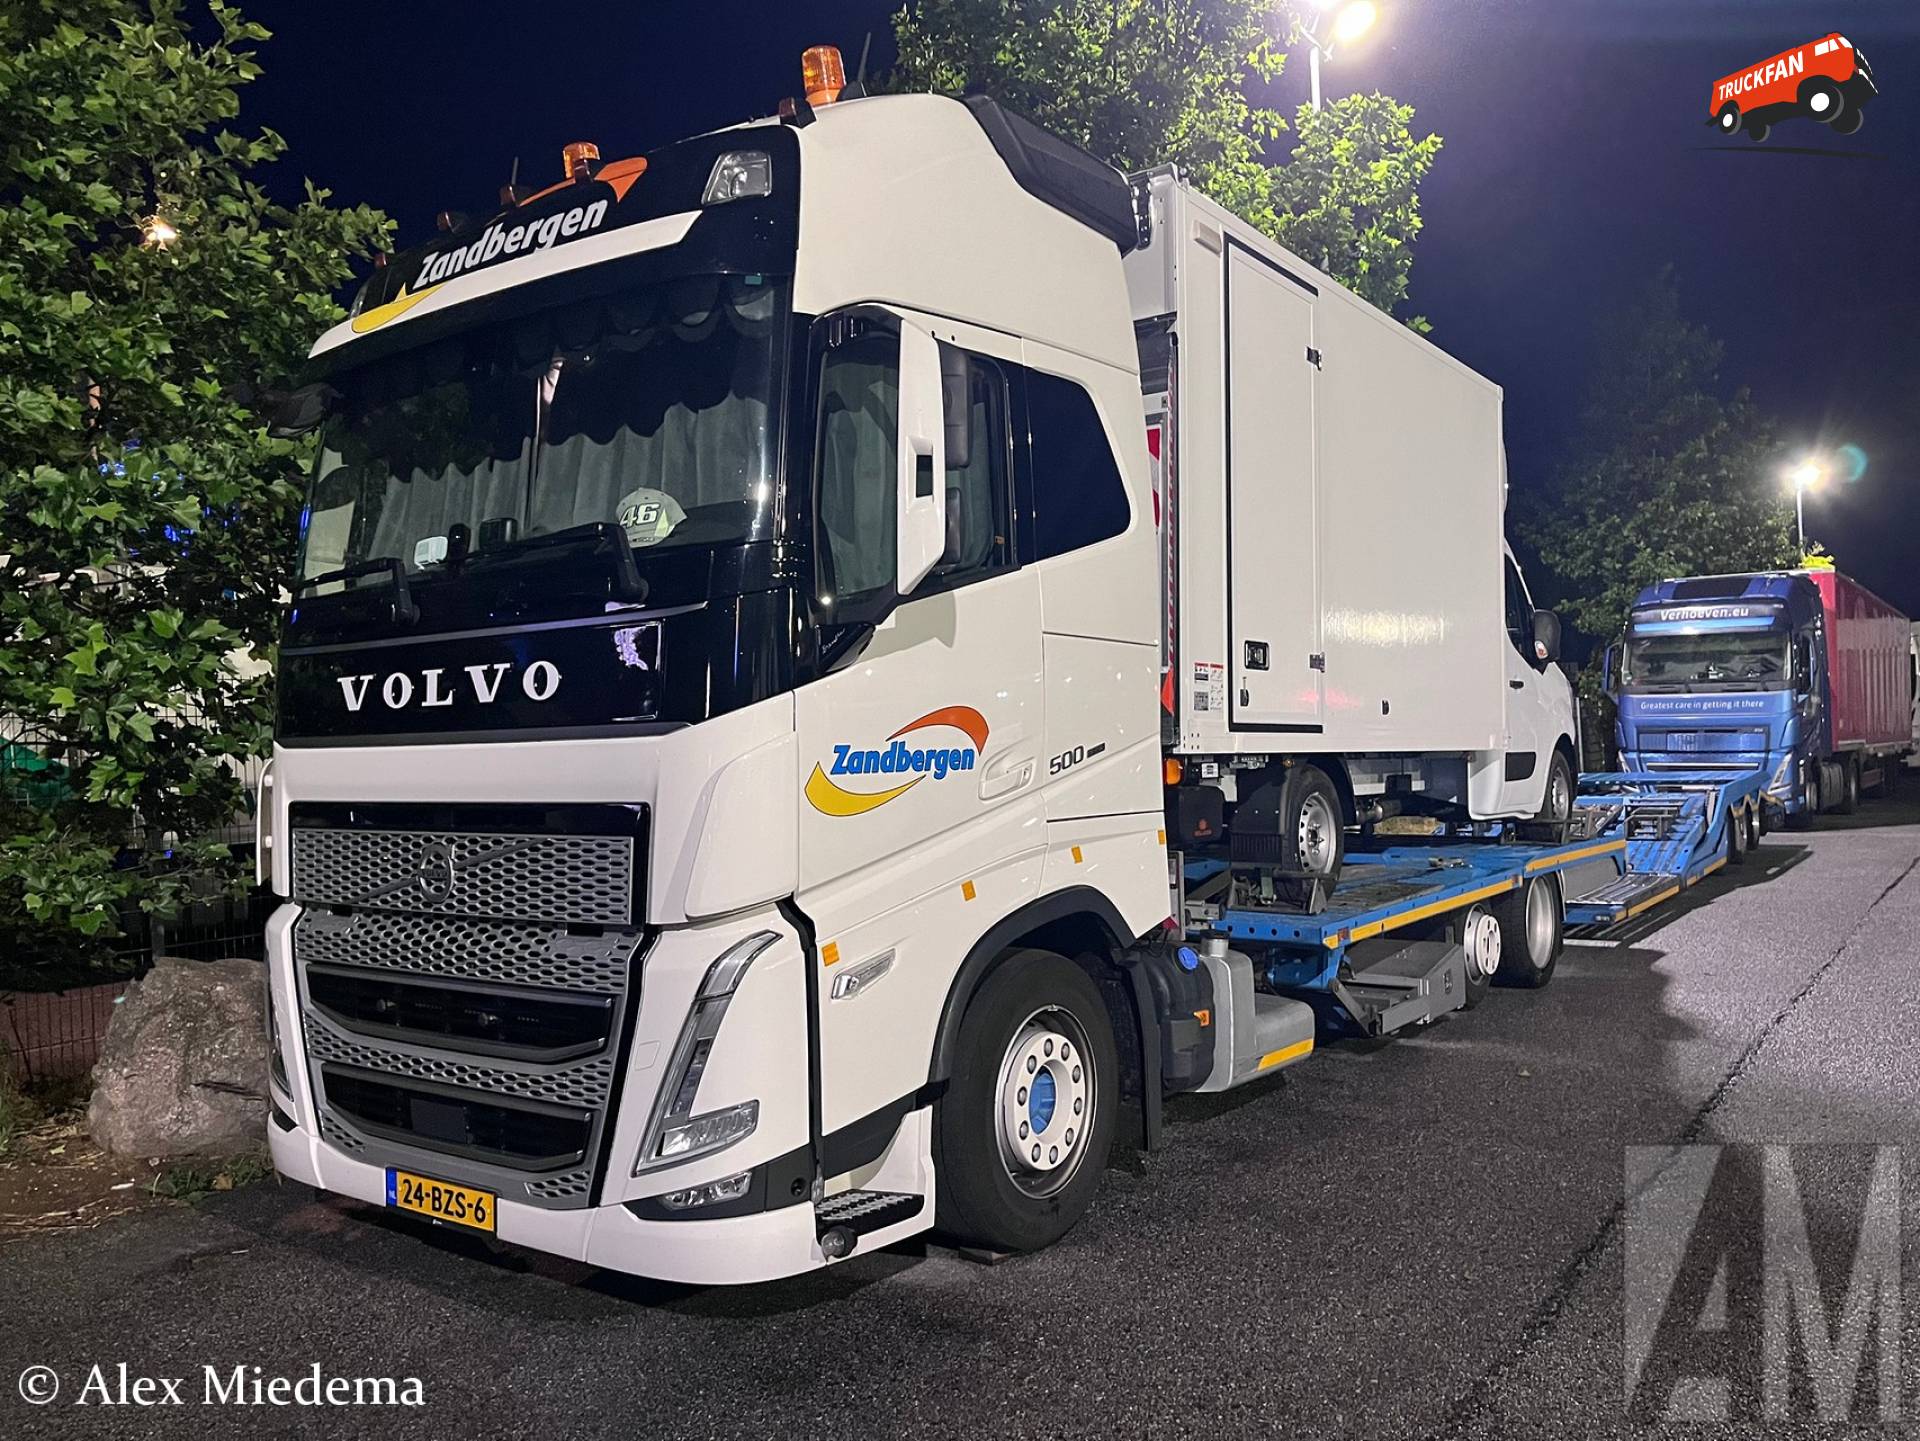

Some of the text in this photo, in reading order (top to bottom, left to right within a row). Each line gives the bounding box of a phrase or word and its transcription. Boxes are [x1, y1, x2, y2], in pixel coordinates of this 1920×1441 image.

[412, 199, 609, 291] Zandbergen
[620, 503, 661, 529] 46
[1660, 608, 1749, 621] Verhoeven.eu
[337, 660, 561, 711] VOLVO
[1640, 701, 1674, 710] Greatest
[1702, 701, 1732, 710] getting
[1741, 700, 1764, 708] there
[830, 741, 975, 780] Zandbergen
[1050, 746, 1085, 776] 500
[402, 1178, 486, 1224] 24-BZS-6
